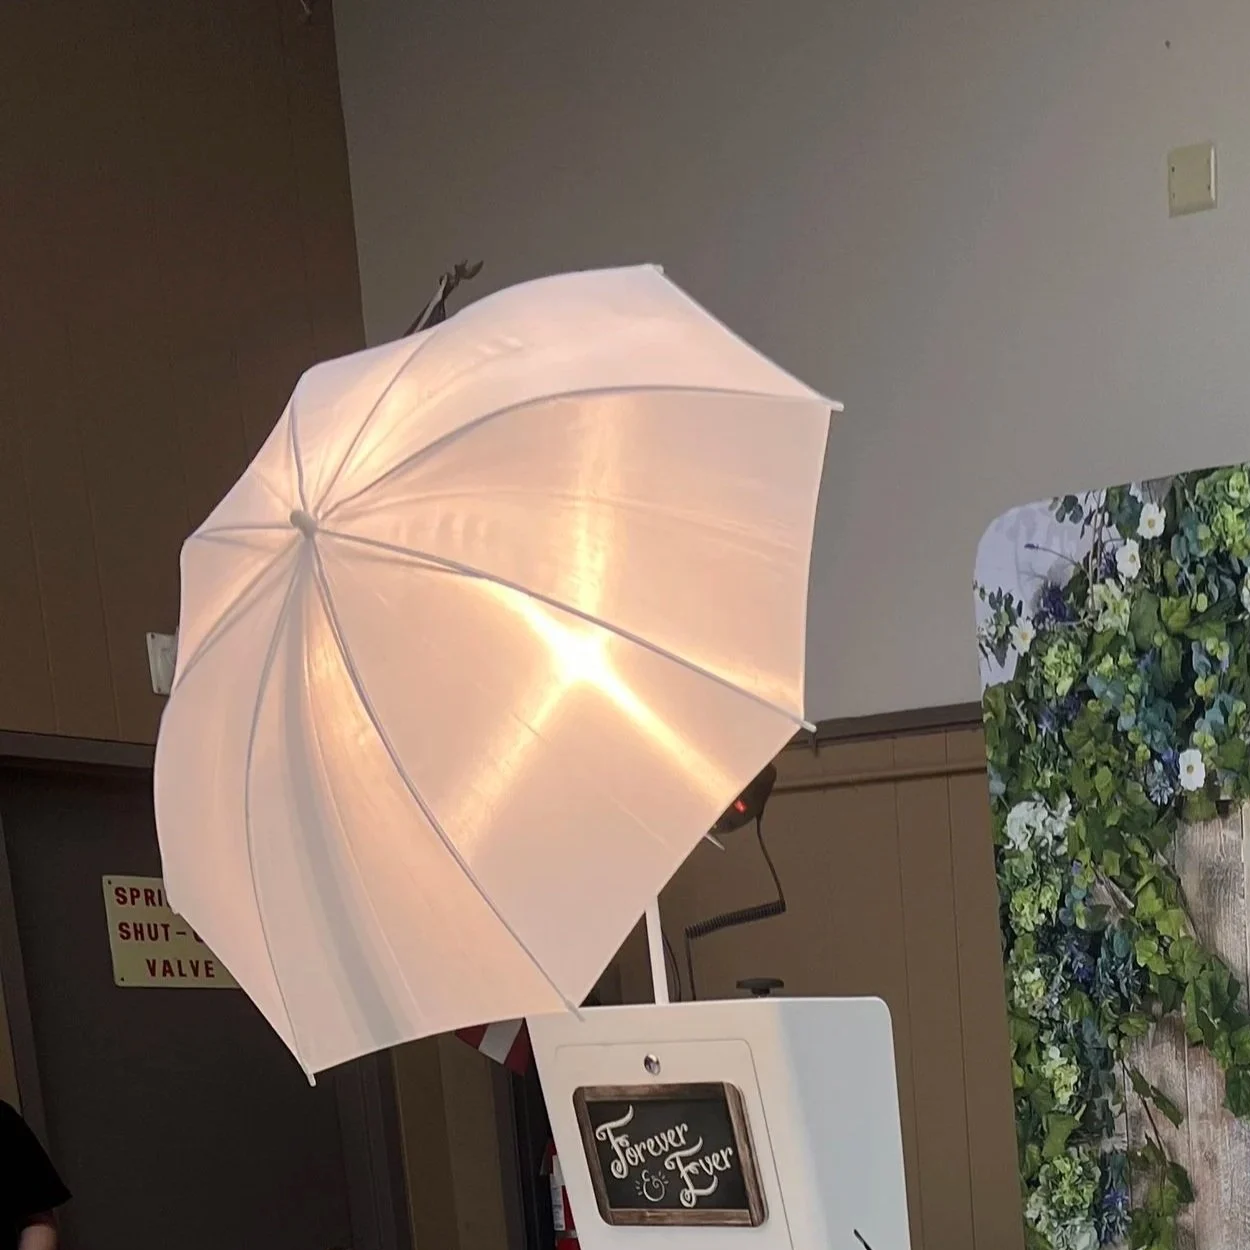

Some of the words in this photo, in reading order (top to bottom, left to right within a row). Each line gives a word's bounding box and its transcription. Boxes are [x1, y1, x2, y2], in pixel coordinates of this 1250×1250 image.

[114, 886, 171, 908] SPRI
[146, 958, 215, 978] VALVE
[595, 1104, 689, 1180] Forever
[641, 1169, 666, 1202] &
[664, 1136, 734, 1208] Ever
